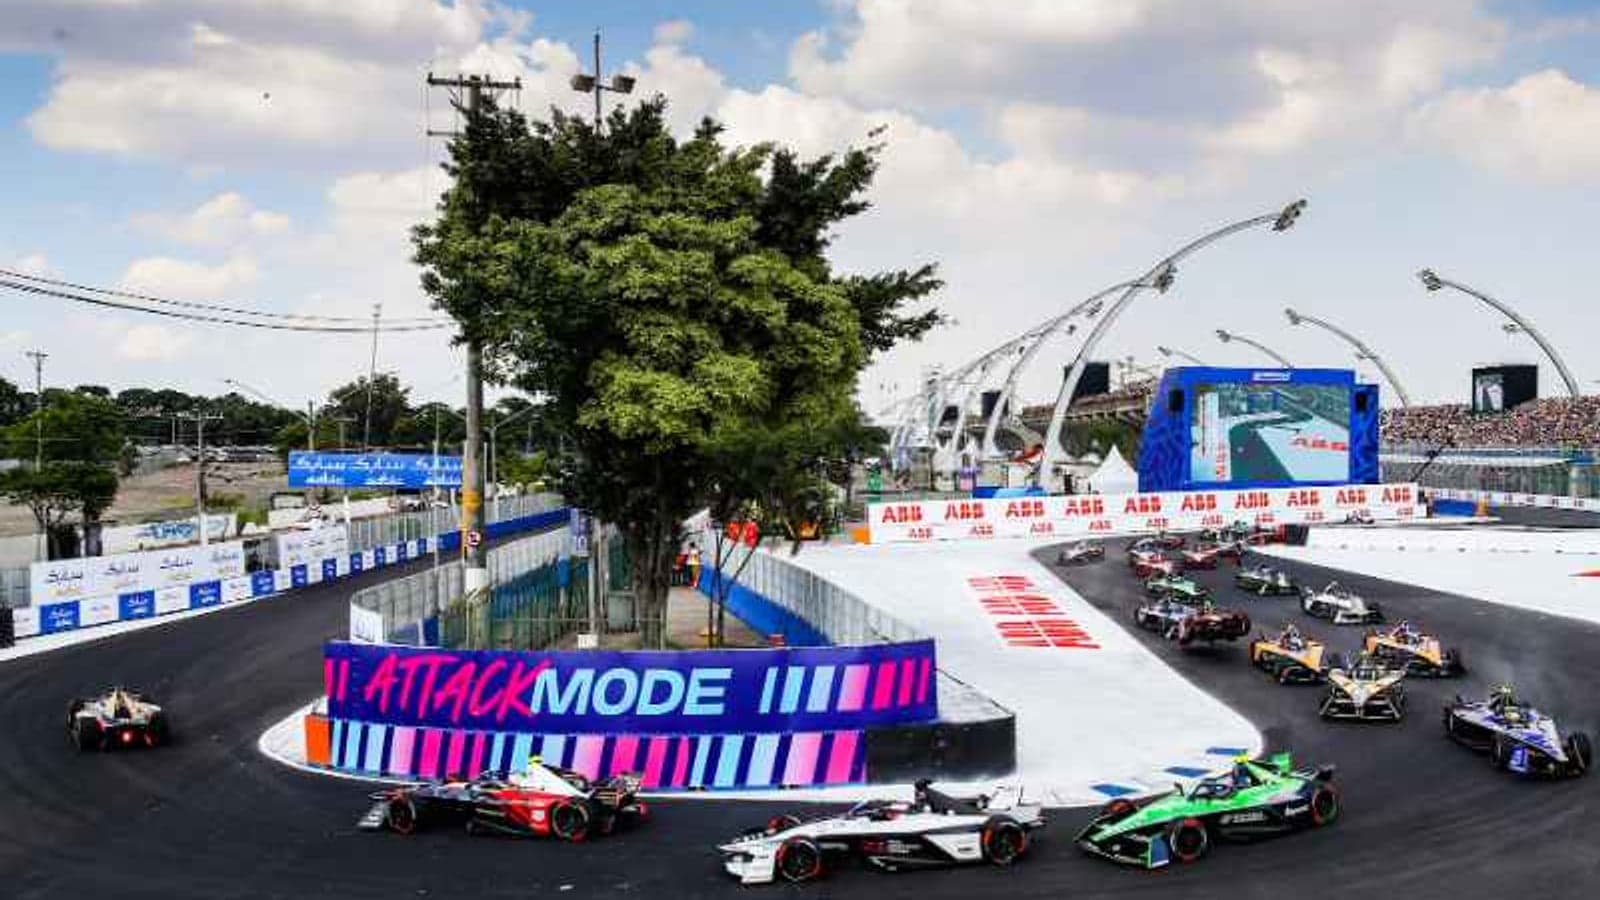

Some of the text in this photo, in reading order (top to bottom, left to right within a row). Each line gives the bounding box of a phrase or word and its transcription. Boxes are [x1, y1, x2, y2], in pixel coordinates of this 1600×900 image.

[882, 487, 1412, 523] ABB ABB ABB ABB ABB ABB ABB ABB ABB ABB
[364, 652, 732, 722] ATTACK MODE
